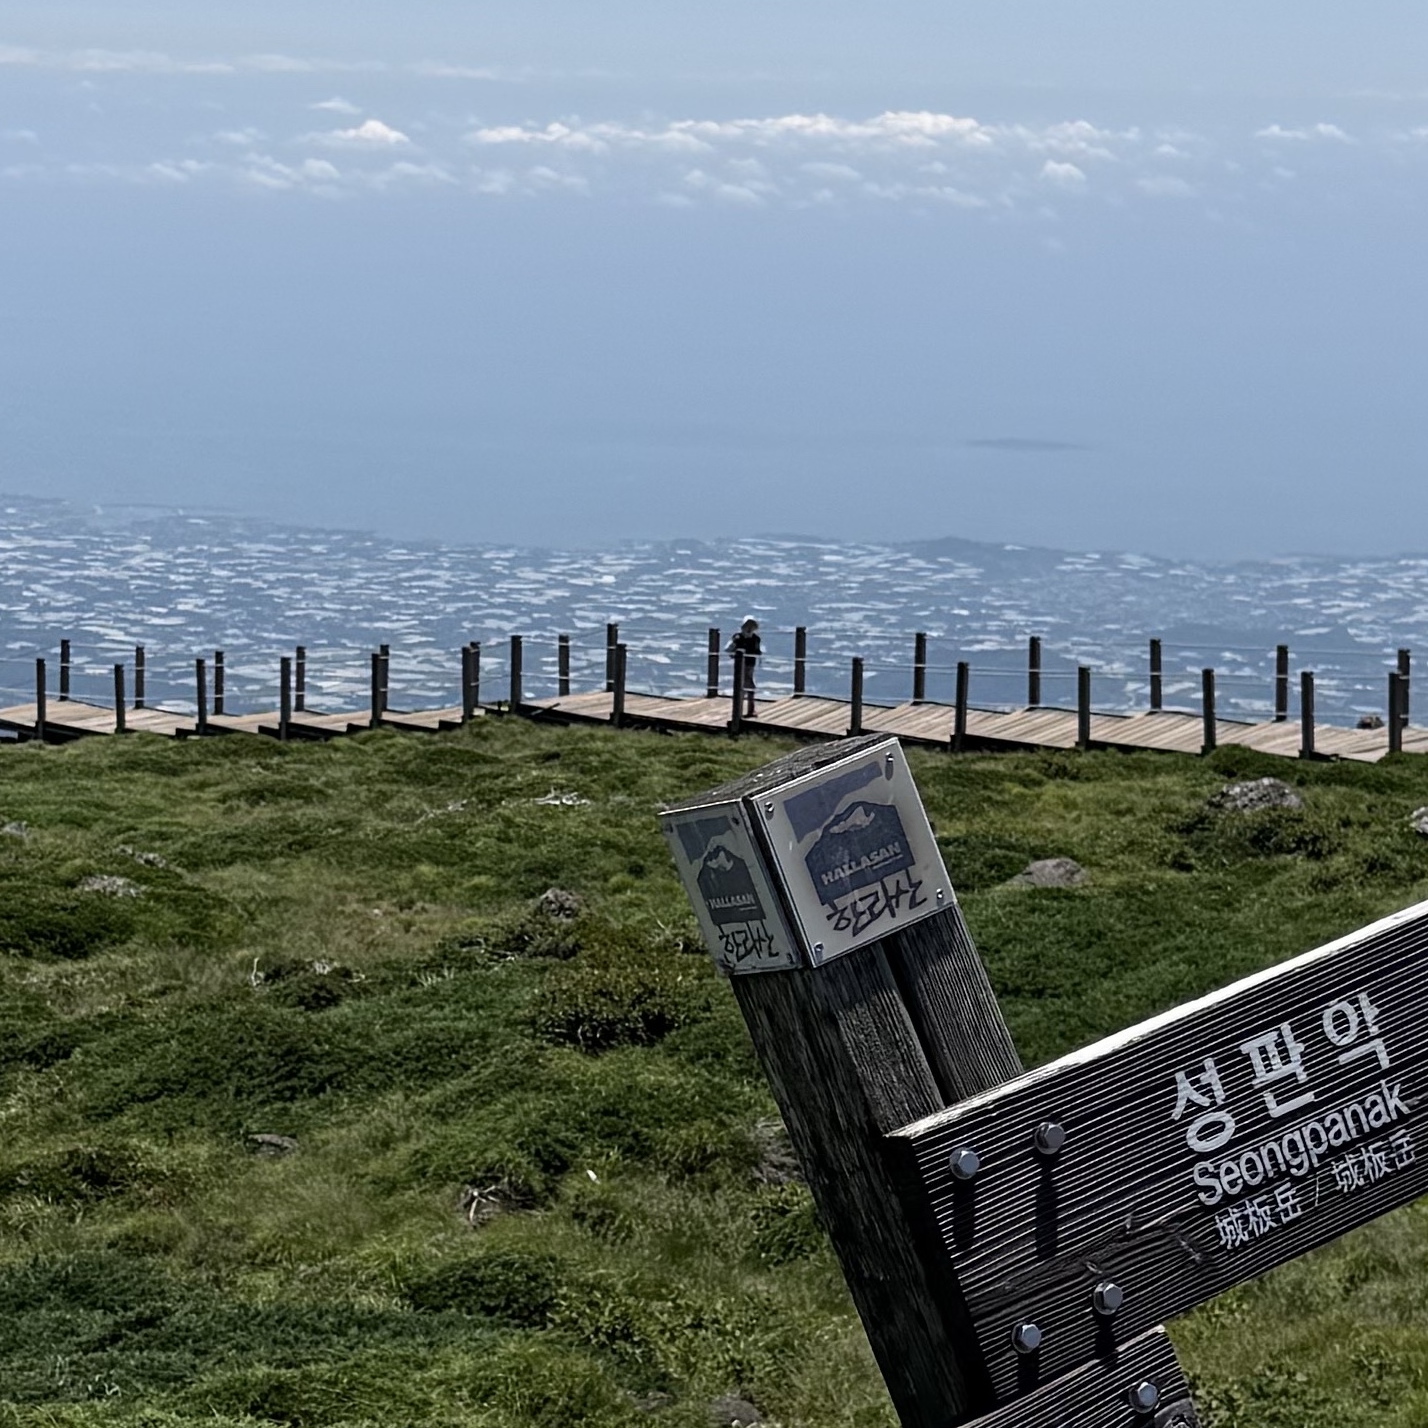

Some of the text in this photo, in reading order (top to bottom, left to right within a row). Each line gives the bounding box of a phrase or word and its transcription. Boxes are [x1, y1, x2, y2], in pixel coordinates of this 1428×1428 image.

[821, 842, 903, 885] HALLASAN
[1172, 992, 1390, 1153] 성판악
[1193, 1080, 1411, 1206] Seongpanak
[1215, 1182, 1302, 1250] 城板岳
[1331, 1129, 1416, 1193] 城板岳
